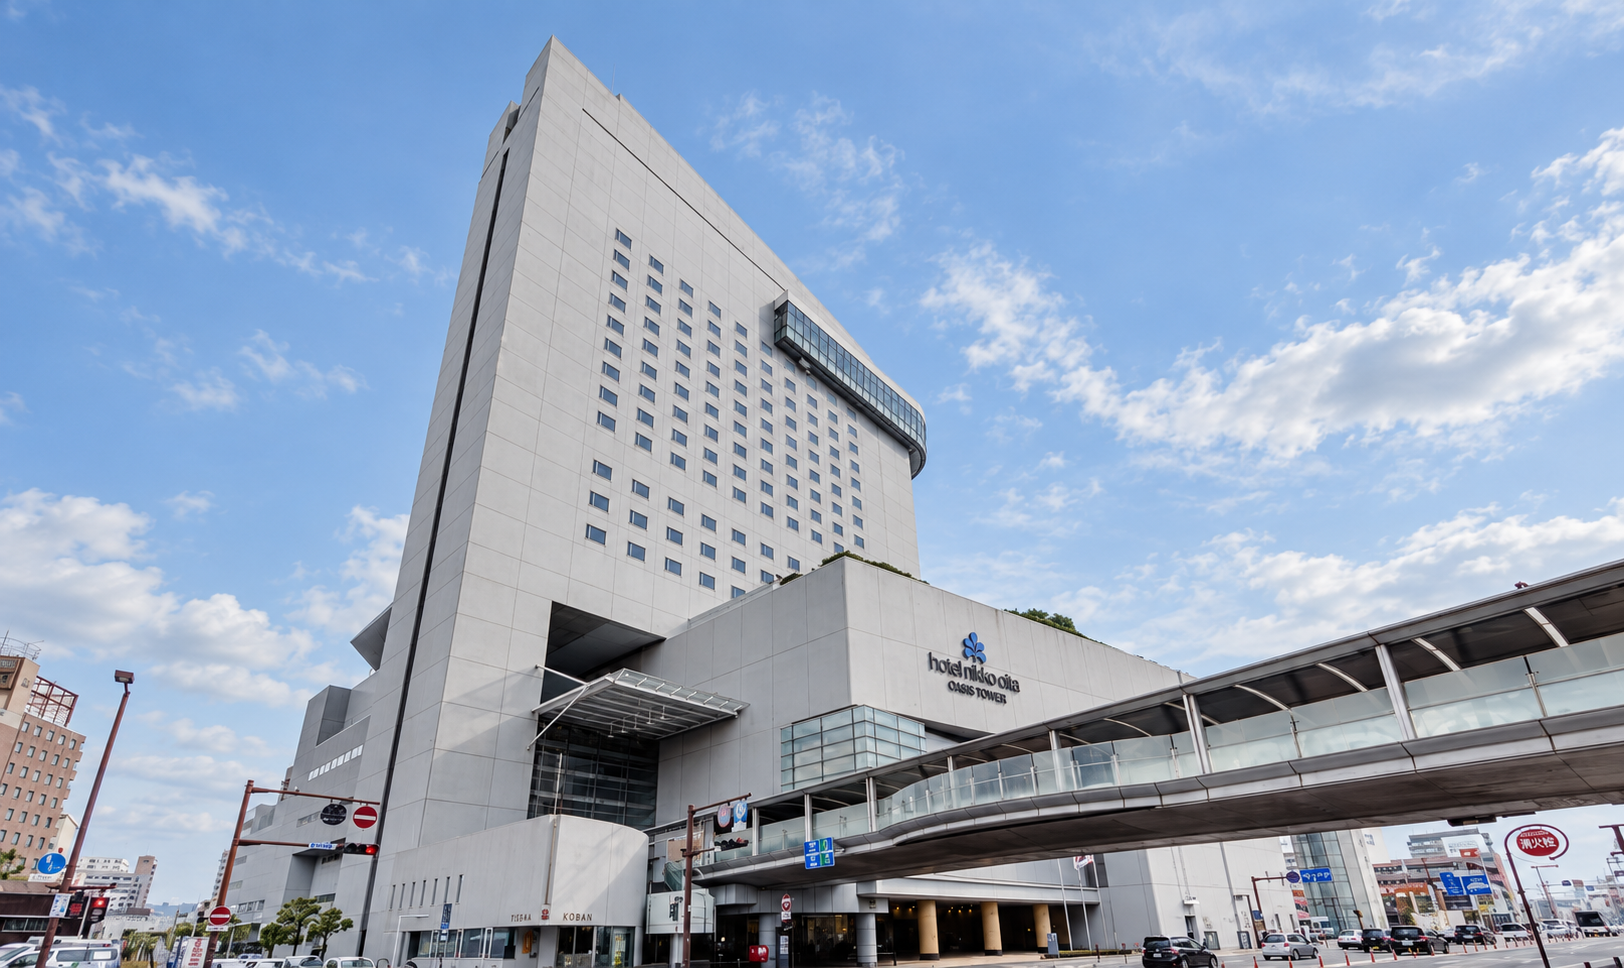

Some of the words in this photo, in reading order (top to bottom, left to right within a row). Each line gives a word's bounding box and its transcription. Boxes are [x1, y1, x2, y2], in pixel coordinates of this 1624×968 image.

[928, 652, 962, 678] hotel
[964, 665, 996, 686] nikko
[998, 674, 1020, 692] oita
[948, 680, 975, 697] OASIS
[976, 687, 1007, 704] TOWER
[563, 912, 593, 921] KOBAN
